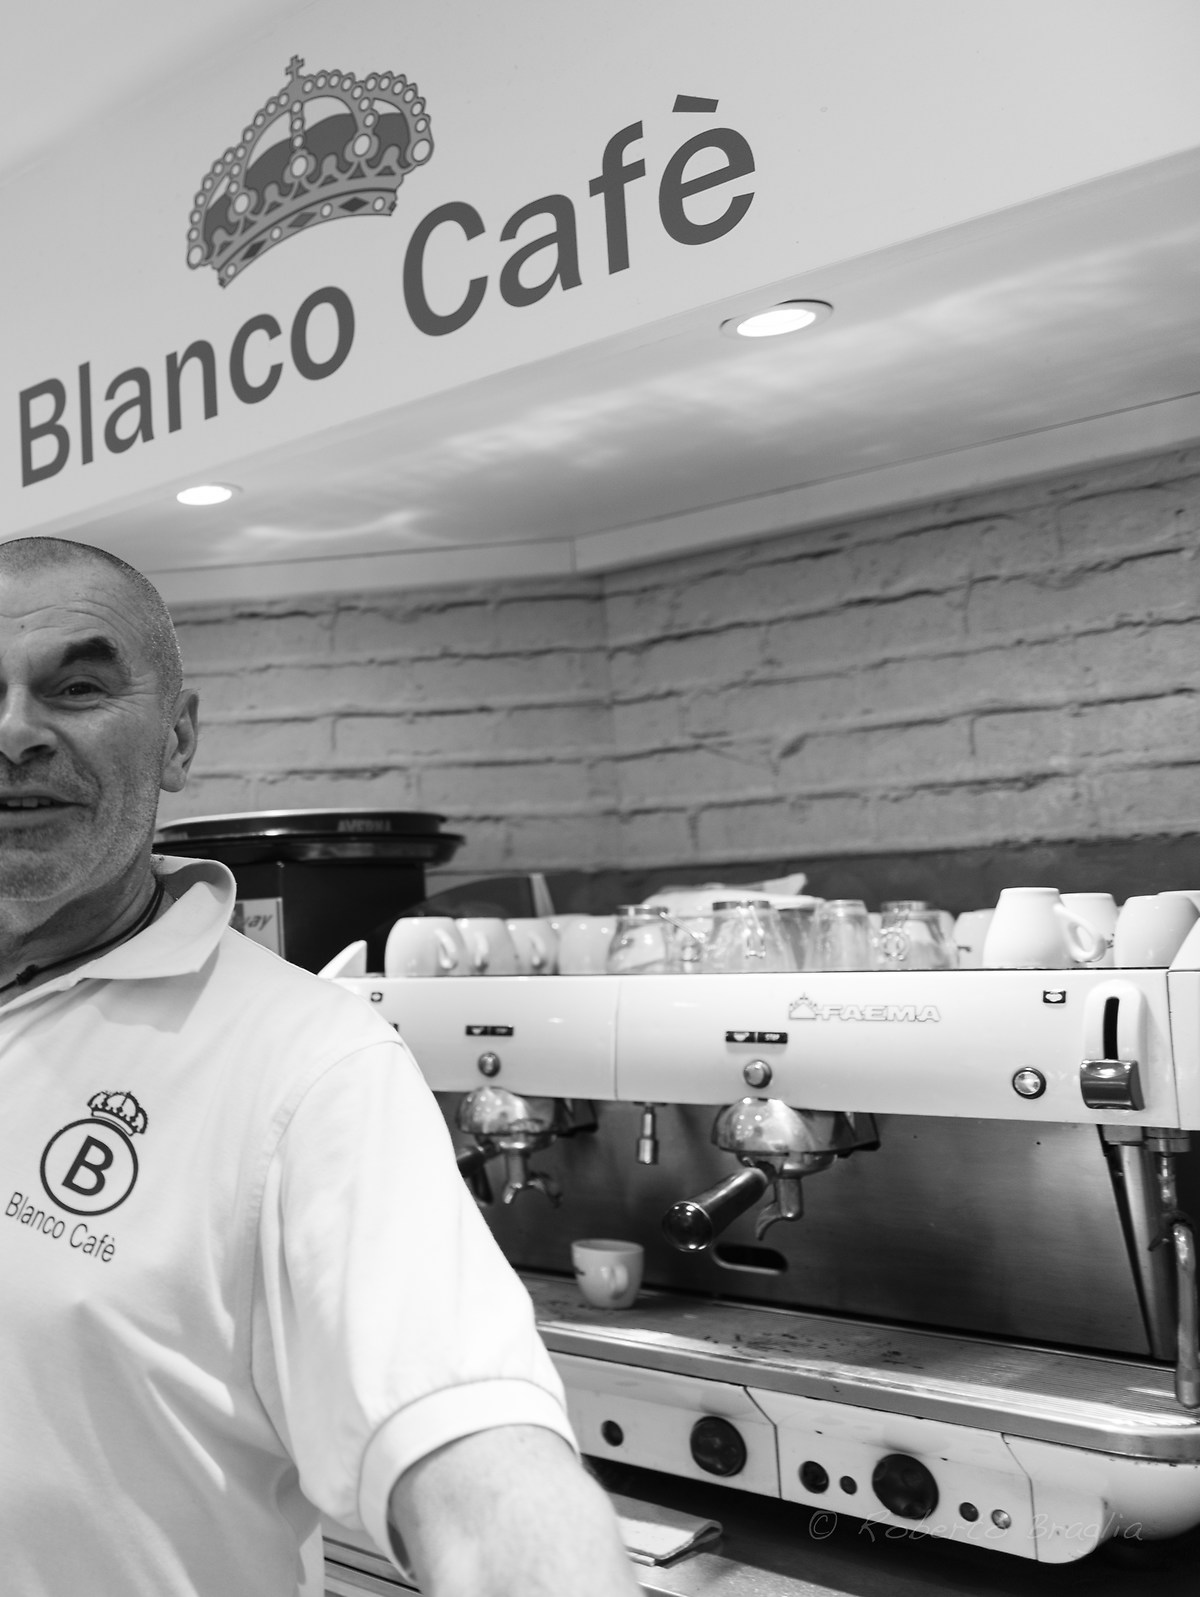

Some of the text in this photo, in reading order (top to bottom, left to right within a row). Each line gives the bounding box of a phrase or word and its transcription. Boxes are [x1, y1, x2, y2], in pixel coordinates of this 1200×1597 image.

[19, 94, 756, 487] Blanco Cafè
[815, 1004, 941, 1023] FAEMA
[62, 1134, 114, 1197] B
[5, 1191, 116, 1263] Blanco Cafè
